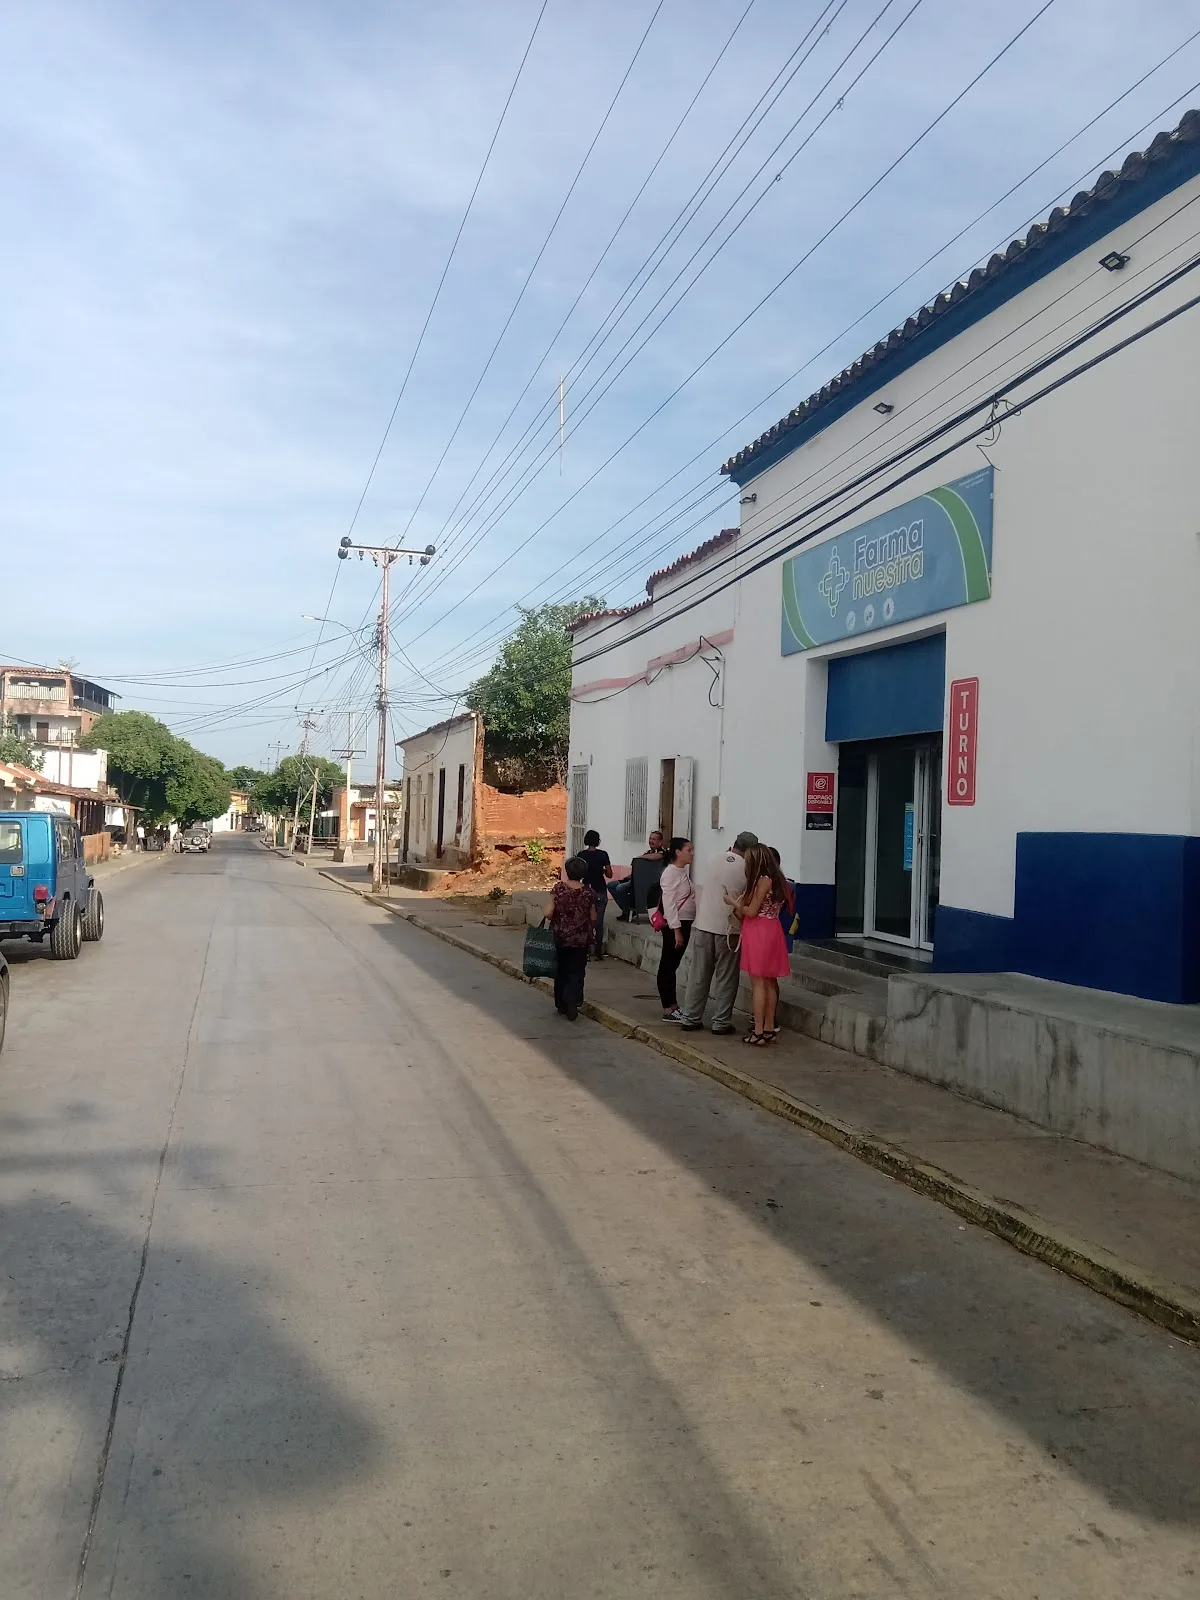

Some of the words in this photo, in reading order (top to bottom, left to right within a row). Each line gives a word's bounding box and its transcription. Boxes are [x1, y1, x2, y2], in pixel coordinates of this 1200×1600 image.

[853, 550, 924, 600] nuestra
[854, 519, 924, 575] Farma
[956, 691, 970, 796] TURNO
